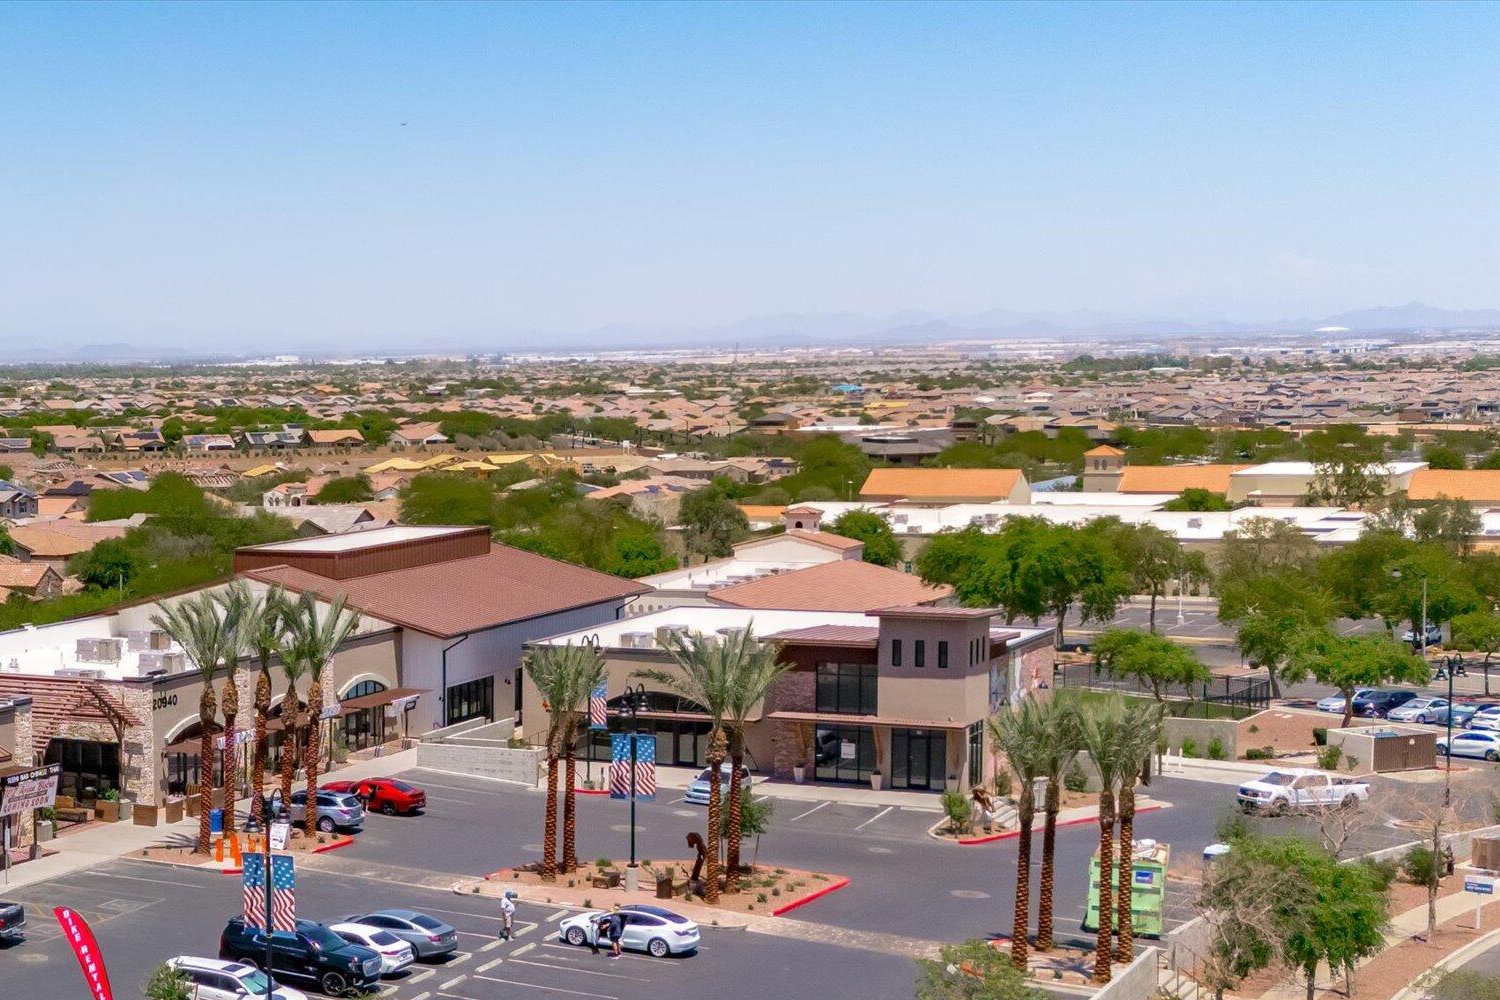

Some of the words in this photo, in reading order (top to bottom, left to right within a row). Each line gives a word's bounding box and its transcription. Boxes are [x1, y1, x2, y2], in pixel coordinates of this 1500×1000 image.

[153, 694, 178, 711] 20940
[20, 773, 30, 782] BAR
[4, 799, 30, 813] COMING
[31, 796, 49, 807] SOON
[63, 909, 82, 942] BIKE
[81, 945, 106, 1000] RENTAL
